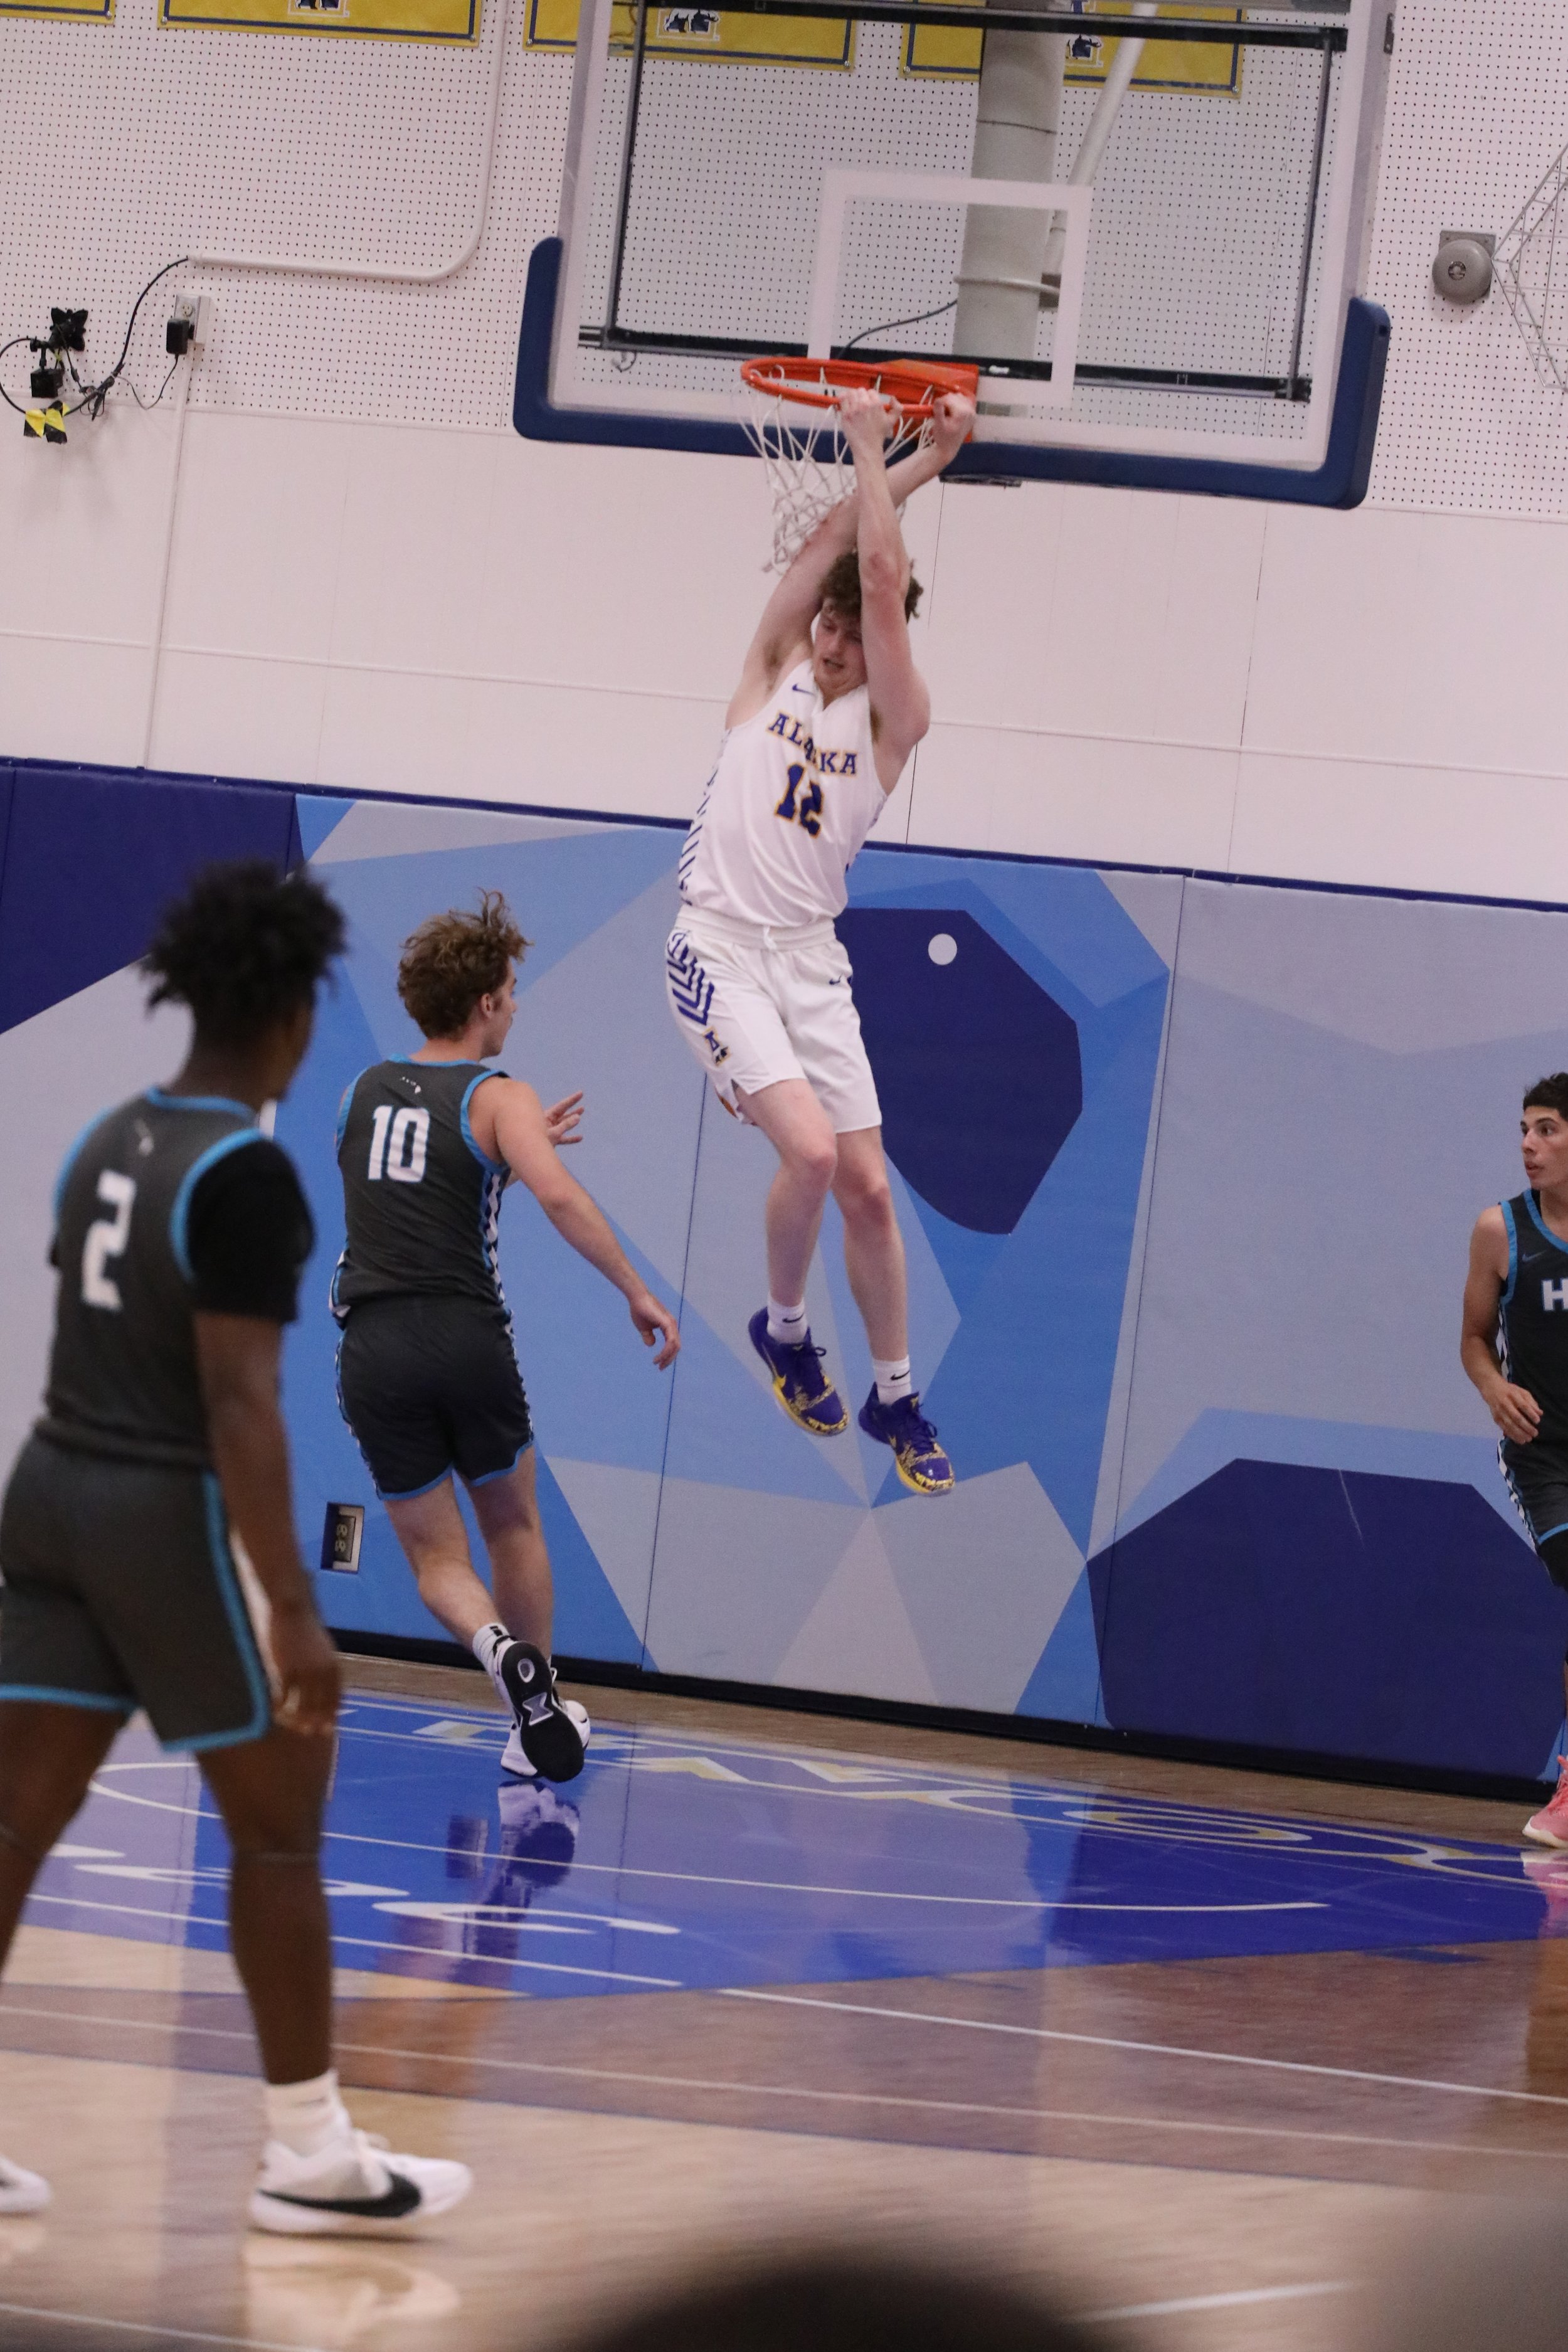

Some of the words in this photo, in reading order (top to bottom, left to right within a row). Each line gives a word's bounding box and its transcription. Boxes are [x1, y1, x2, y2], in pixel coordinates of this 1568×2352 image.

[767, 711, 858, 776] ALAKA
[775, 762, 823, 838] 12
[368, 1104, 430, 1183] 10
[82, 1168, 135, 1311] 2
